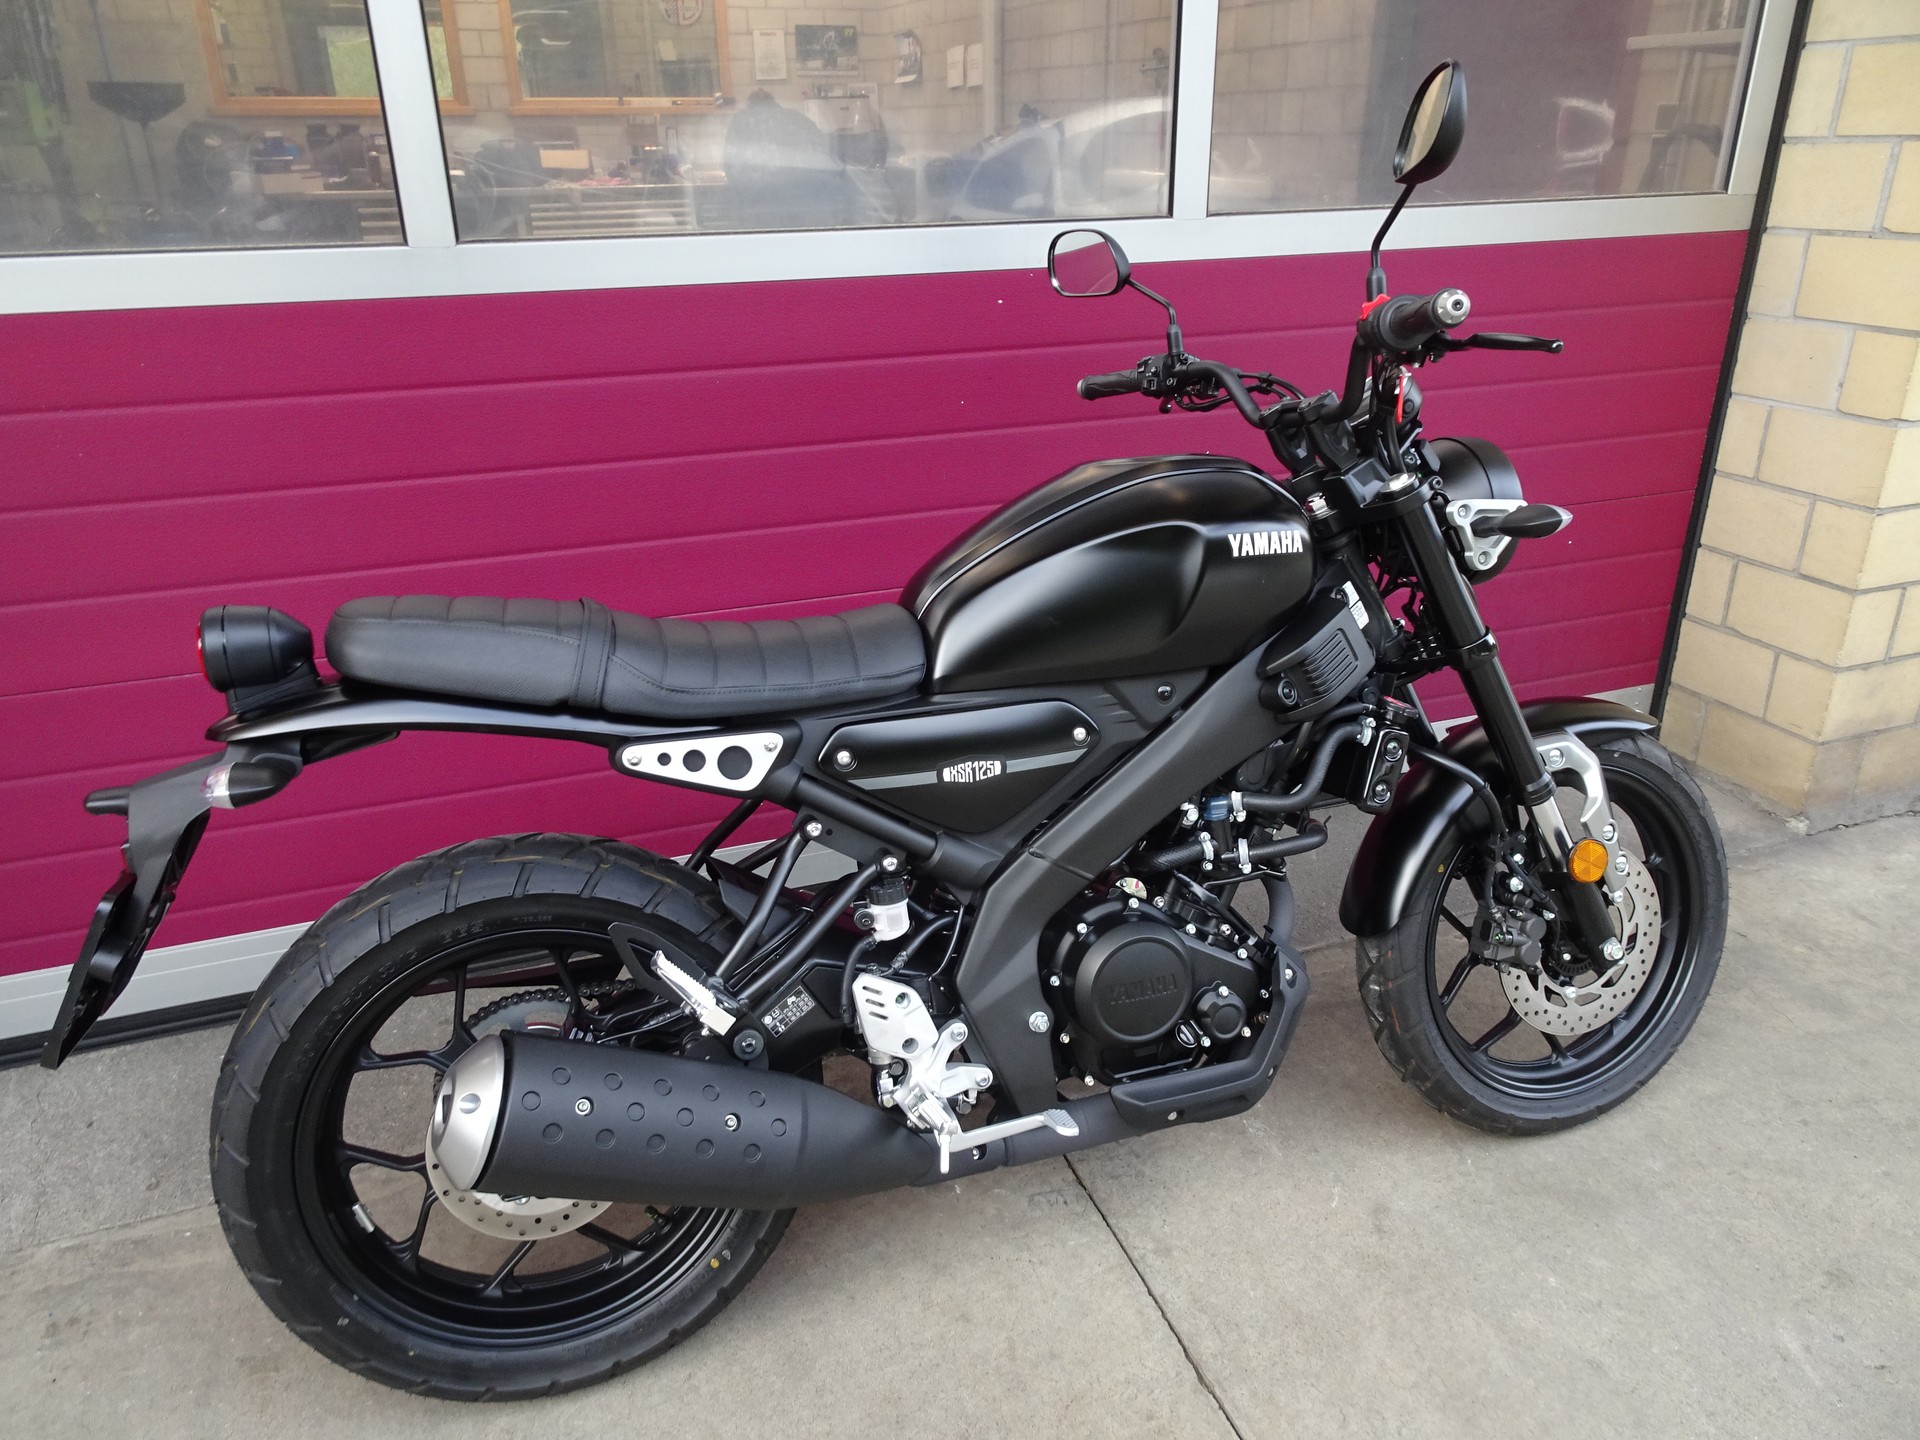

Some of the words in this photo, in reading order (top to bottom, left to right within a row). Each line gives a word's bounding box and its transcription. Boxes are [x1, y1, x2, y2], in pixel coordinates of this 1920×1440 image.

[1228, 530, 1303, 557] YAMAHA
[950, 761, 995, 783] XSR125
[1105, 973, 1178, 1005] YAMAHA
